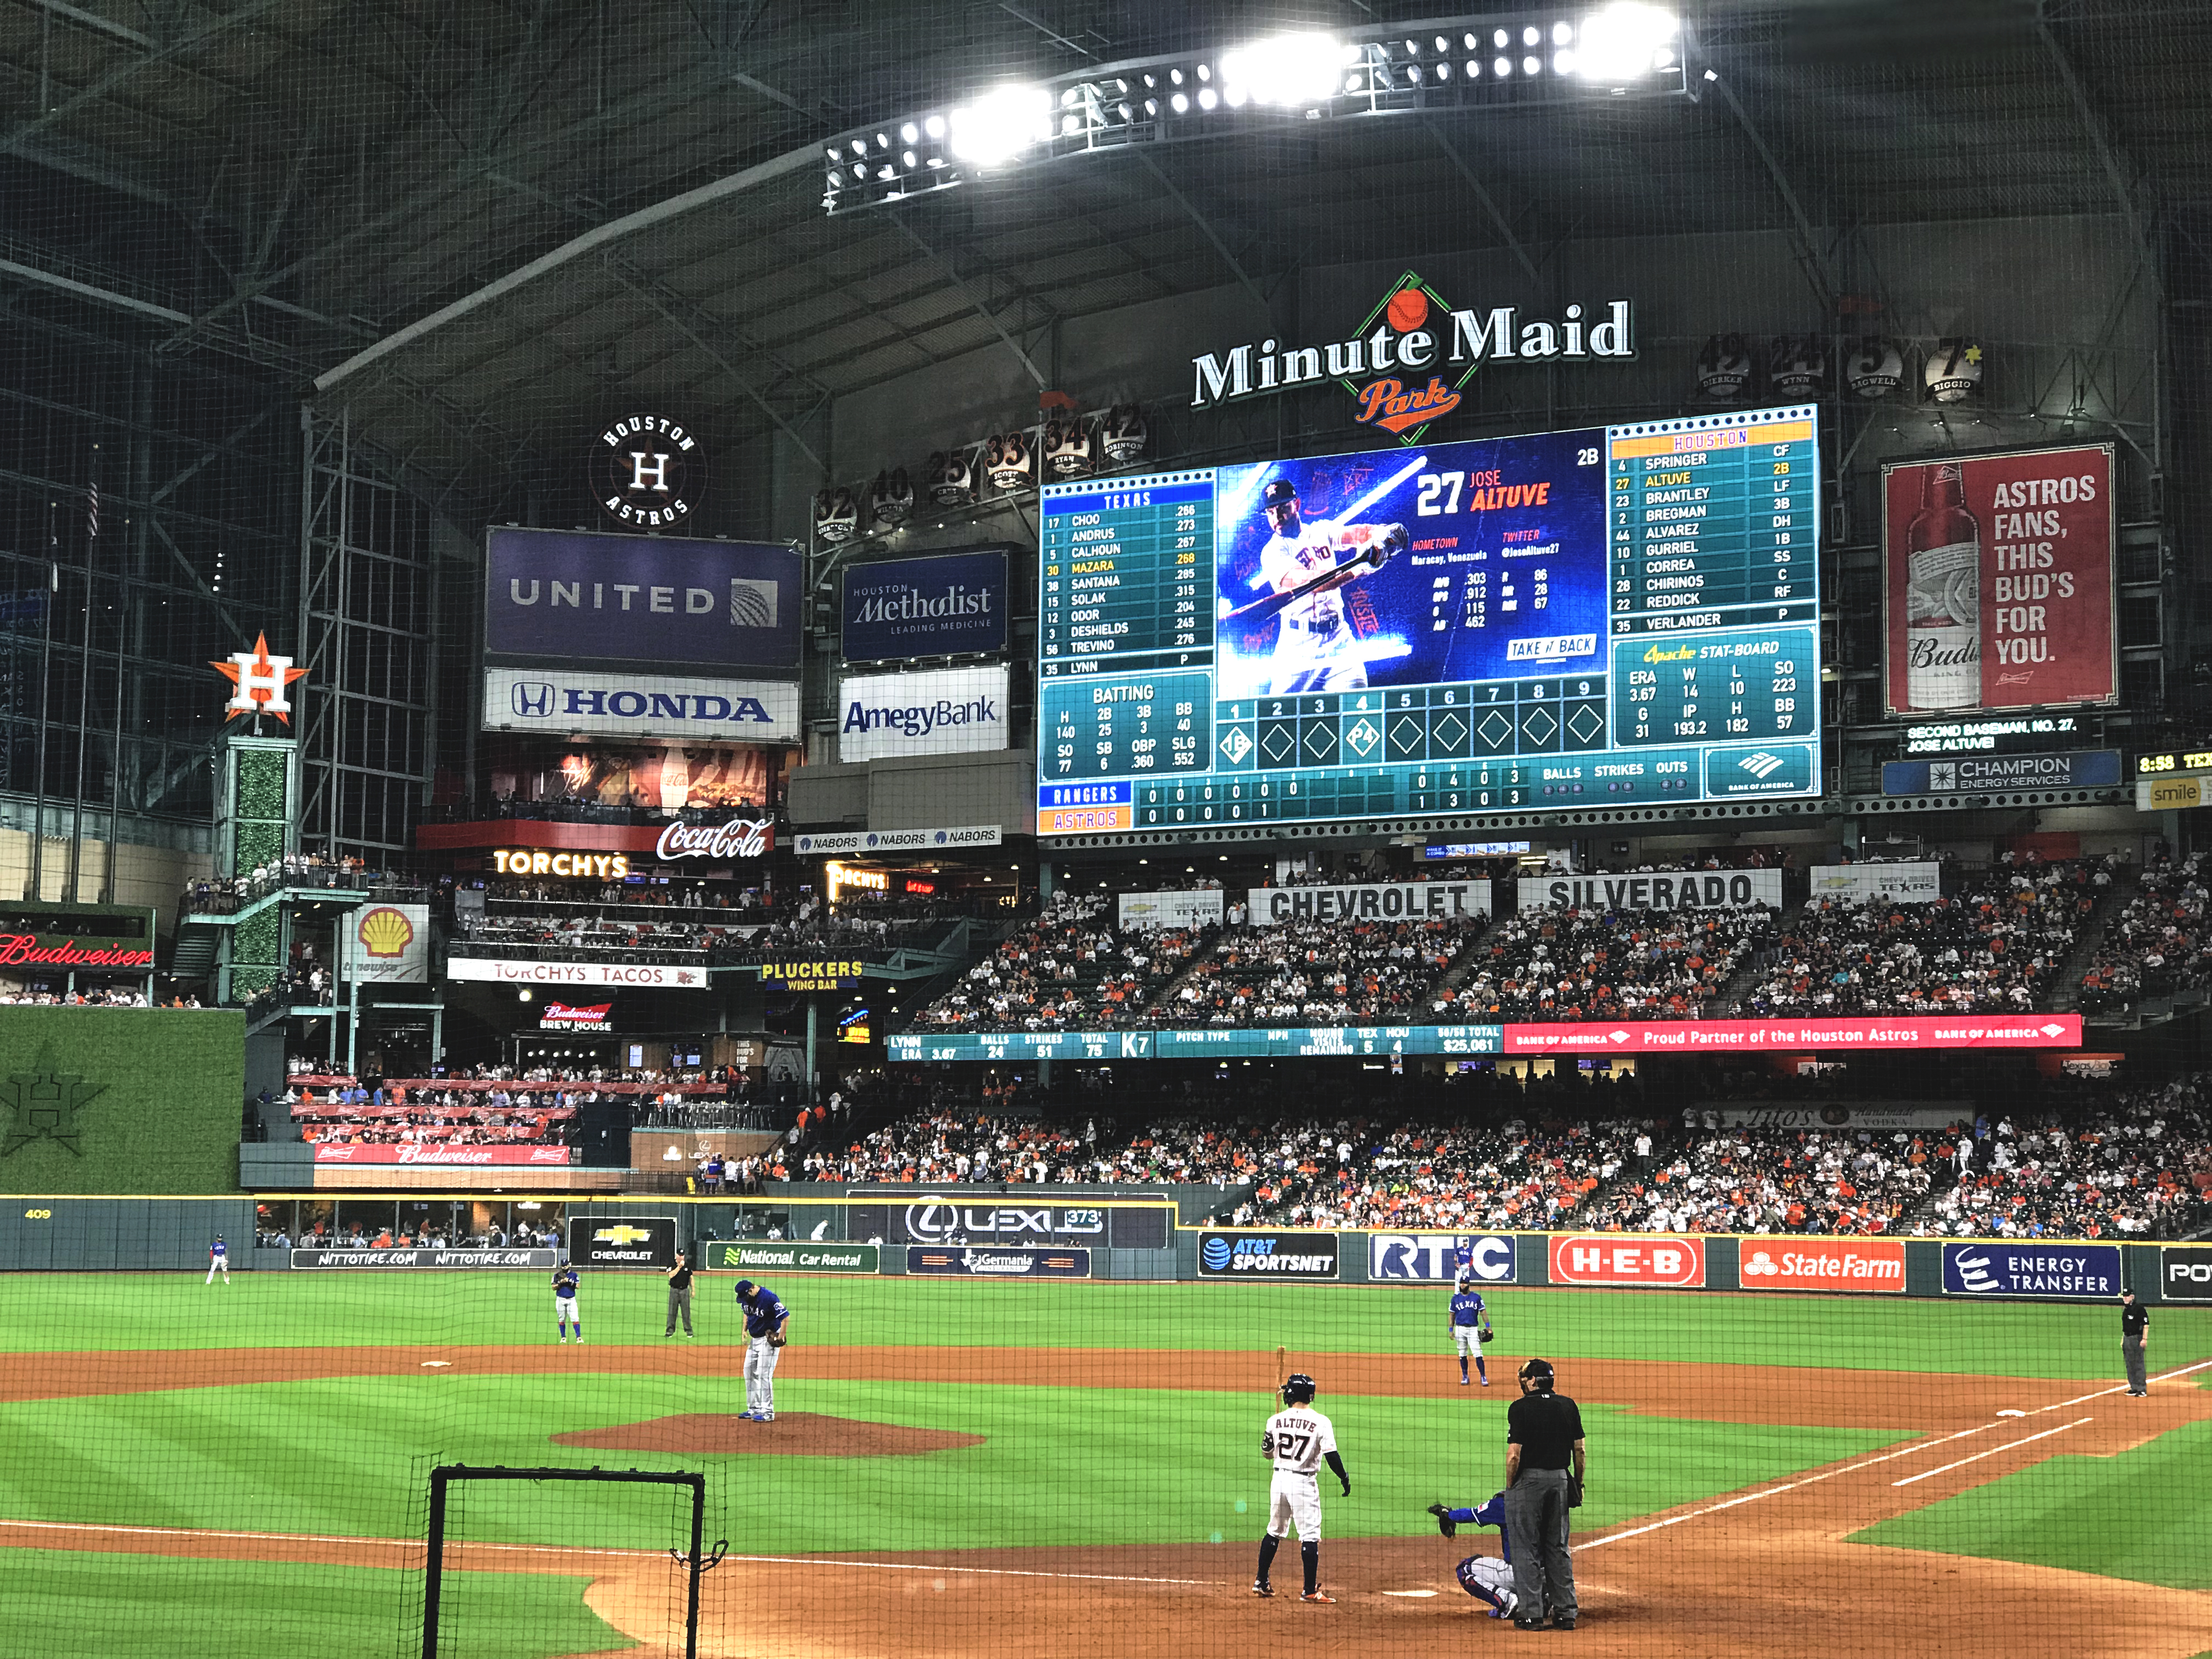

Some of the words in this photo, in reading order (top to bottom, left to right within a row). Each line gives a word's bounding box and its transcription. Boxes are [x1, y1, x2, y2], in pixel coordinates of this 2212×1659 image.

[1191, 325, 1432, 406] Minute
[1449, 301, 1633, 360] Maid
[1703, 375, 1742, 387] DIERKER
[1782, 377, 1810, 385] WYNN
[1852, 377, 1896, 389] BAGWELL
[1934, 381, 1971, 392] BIGGIO
[1355, 376, 1462, 431] Park
[603, 416, 695, 451] HOUSTON
[1044, 417, 1086, 452] 34
[1674, 430, 1748, 450] HOUSTON
[985, 432, 1024, 467] 33
[1645, 453, 1707, 470] SPRINGER
[629, 452, 669, 491] H
[994, 471, 1018, 480] SCOTT
[1469, 470, 1502, 488] JOSE
[1645, 472, 1691, 487] ALTUVE
[1418, 471, 1465, 516] 27
[1470, 482, 1550, 512] ALTUVE
[1646, 487, 1710, 505] BRANTLEY
[1994, 475, 2096, 509] ASTROS
[1104, 492, 1150, 509] TEXAS
[606, 495, 687, 525] ASTROS
[1646, 505, 1707, 522] BREGMAN
[1072, 514, 1099, 526] CHOO
[1995, 510, 2068, 540] FANS,
[1072, 528, 1115, 542] ANDRUS
[1503, 529, 1540, 543] TWITTER
[1646, 523, 1700, 539] ALVAREZ
[1071, 544, 1121, 558] CALHOUN
[1412, 537, 1458, 551] HOMETOWN
[1502, 543, 1560, 558] @JoseAltuve27
[1646, 540, 1699, 557] GURRIEL
[1412, 553, 1446, 566] Maracay,
[1448, 550, 1487, 563] Venezuela
[1994, 542, 2053, 571] THIS
[1072, 560, 1114, 574] MAZARA
[1646, 558, 1695, 574] CORREA
[854, 583, 909, 596] HOUSTON
[1071, 575, 1120, 589] SANTANA
[1646, 575, 1705, 591] CHIRINOS
[1995, 572, 2074, 602] BUD'S
[510, 578, 714, 614] UNITED
[854, 585, 991, 623] Methodist
[1071, 592, 1106, 606] SOLAK
[1647, 592, 1701, 608] REDDICK
[1071, 609, 1099, 622] ODOR
[1646, 613, 1721, 630] VERLANDER
[1996, 606, 2046, 634] FOR
[890, 624, 935, 635] LEADING
[941, 619, 991, 630] MEDICINE
[1071, 622, 1128, 637] DESHIELDS
[1070, 640, 1114, 653] TREVINO
[1644, 645, 1697, 665] Apache
[1699, 641, 1780, 659] STAT-BOARD
[1995, 636, 2056, 664] YOU.
[1071, 661, 1098, 674] LYNN
[226, 653, 292, 712] H
[1093, 685, 1154, 704] BATTING
[563, 689, 774, 723] HONDA
[1908, 725, 1961, 739] SECOND
[2032, 720, 2056, 733] NO.
[1908, 741, 1941, 753] JOSE
[1543, 766, 1581, 780] BALLS
[1594, 763, 1644, 778] STRIKES
[1656, 761, 1688, 774] OUTS
[1959, 758, 2070, 777] CHAMPION
[2140, 754, 2175, 772] 8:58
[1960, 778, 2008, 789] ENERGY
[2010, 775, 2070, 786] SERVICES
[1054, 786, 1117, 803] RANGERS
[2154, 785, 2197, 801] smile
[1054, 810, 1117, 830] ASTROS
[656, 818, 774, 860] Coca-Cola
[813, 837, 857, 849] NABORS
[881, 834, 926, 845] NABORS
[950, 830, 996, 842] NABORS
[493, 851, 629, 878] TORCHYS
[1549, 874, 1752, 910] SILVERADO
[1271, 885, 1468, 921] CHEVROLET
[0, 934, 154, 965] Budweiser
[494, 963, 586, 981] TORCHYS
[601, 967, 663, 984] TACOS
[763, 961, 862, 979] PLUCKERS
[787, 980, 815, 991] WING
[817, 979, 837, 990] BAR
[544, 1005, 605, 1019] Budweiser
[540, 1019, 572, 1030] BREW
[574, 1020, 612, 1031] HOUSE
[1357, 1028, 1378, 1039] TEX
[1386, 1027, 1409, 1039] HOU
[1469, 1025, 1500, 1037] TOTAL
[890, 1036, 921, 1048] LYNN
[980, 1034, 1009, 1045] BALLS
[1025, 1034, 1063, 1045] STRIKES
[1081, 1033, 1108, 1043] TOTAL
[1176, 1031, 1204, 1042] PITCH
[1206, 1030, 1230, 1042] TYPE
[1268, 1029, 1289, 1041] MPH
[1310, 1028, 1344, 1039] MOUND
[1516, 1036, 1544, 1045] BANK
[1546, 1036, 1560, 1045] OF
[1561, 1035, 1607, 1044] AMERICA
[1644, 1031, 1685, 1044] Proud
[1691, 1031, 1745, 1043] Partner
[1750, 1029, 1765, 1043] of
[1771, 1029, 1795, 1042] the
[1801, 1029, 1863, 1042] Houston
[1869, 1029, 1918, 1041] Astros
[1935, 1029, 1967, 1039] BANK
[1968, 1029, 1985, 1039] OF
[1986, 1028, 2039, 1039] AMERICA
[1313, 1037, 1344, 1047] VISITS
[1443, 1039, 1493, 1053] $25,061
[901, 1048, 922, 1060] ERA
[988, 1045, 1004, 1058] 24
[1037, 1045, 1052, 1058] 51
[1086, 1045, 1102, 1057] 75
[1300, 1045, 1353, 1056] REMAINING
[395, 1145, 493, 1164] Budweiser
[25, 1209, 51, 1219] 409
[1232, 1239, 1277, 1255] AT&T
[318, 1251, 417, 1266] NITTOTIRE.COM
[435, 1251, 531, 1265] NITTOTIRE.COM
[591, 1251, 653, 1260] CHEVROLET
[799, 1254, 820, 1266] Car
[821, 1254, 861, 1266] Rental
[980, 1253, 1033, 1266] Germania
[1232, 1254, 1334, 1272] SPORTSNET
[1572, 1247, 1681, 1274] H-E-B
[2008, 1256, 2086, 1273] ENERGY
[2170, 1263, 2212, 1282] PO
[2010, 1274, 2109, 1292] TRANSFER
[1455, 1300, 1478, 1311] TEXAS
[1276, 1418, 1317, 1434] ALTUVE
[1278, 1432, 1310, 1461] 27
